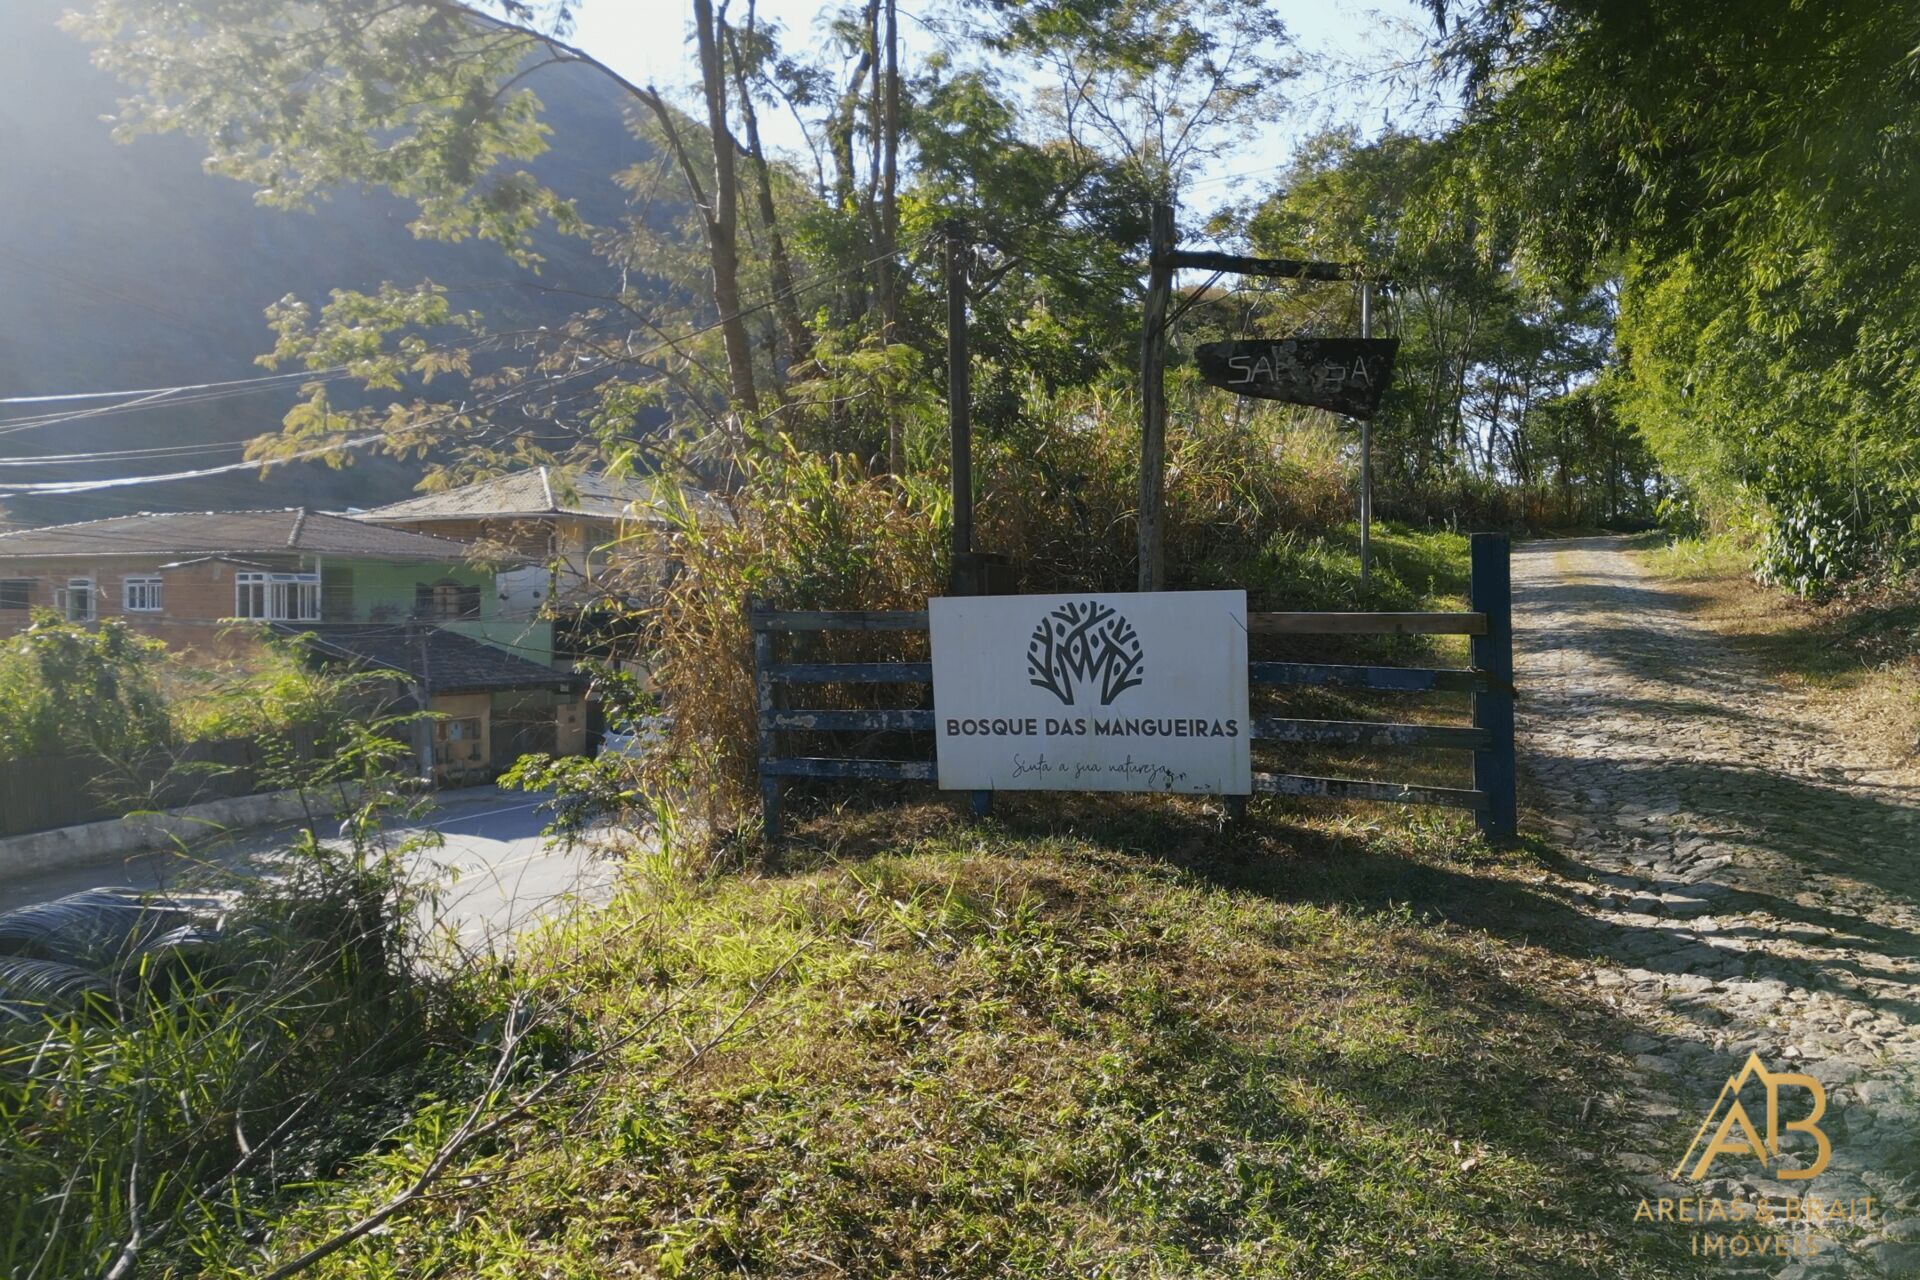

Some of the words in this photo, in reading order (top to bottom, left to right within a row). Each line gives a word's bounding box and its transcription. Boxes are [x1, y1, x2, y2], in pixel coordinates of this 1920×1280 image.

[947, 719, 1037, 736] BOSQUE
[1045, 719, 1087, 736] DAS
[1095, 719, 1238, 737] MANGUEIRAS
[1013, 754, 1052, 778] Sinta
[1059, 764, 1070, 774] a
[1075, 763, 1102, 779] sua
